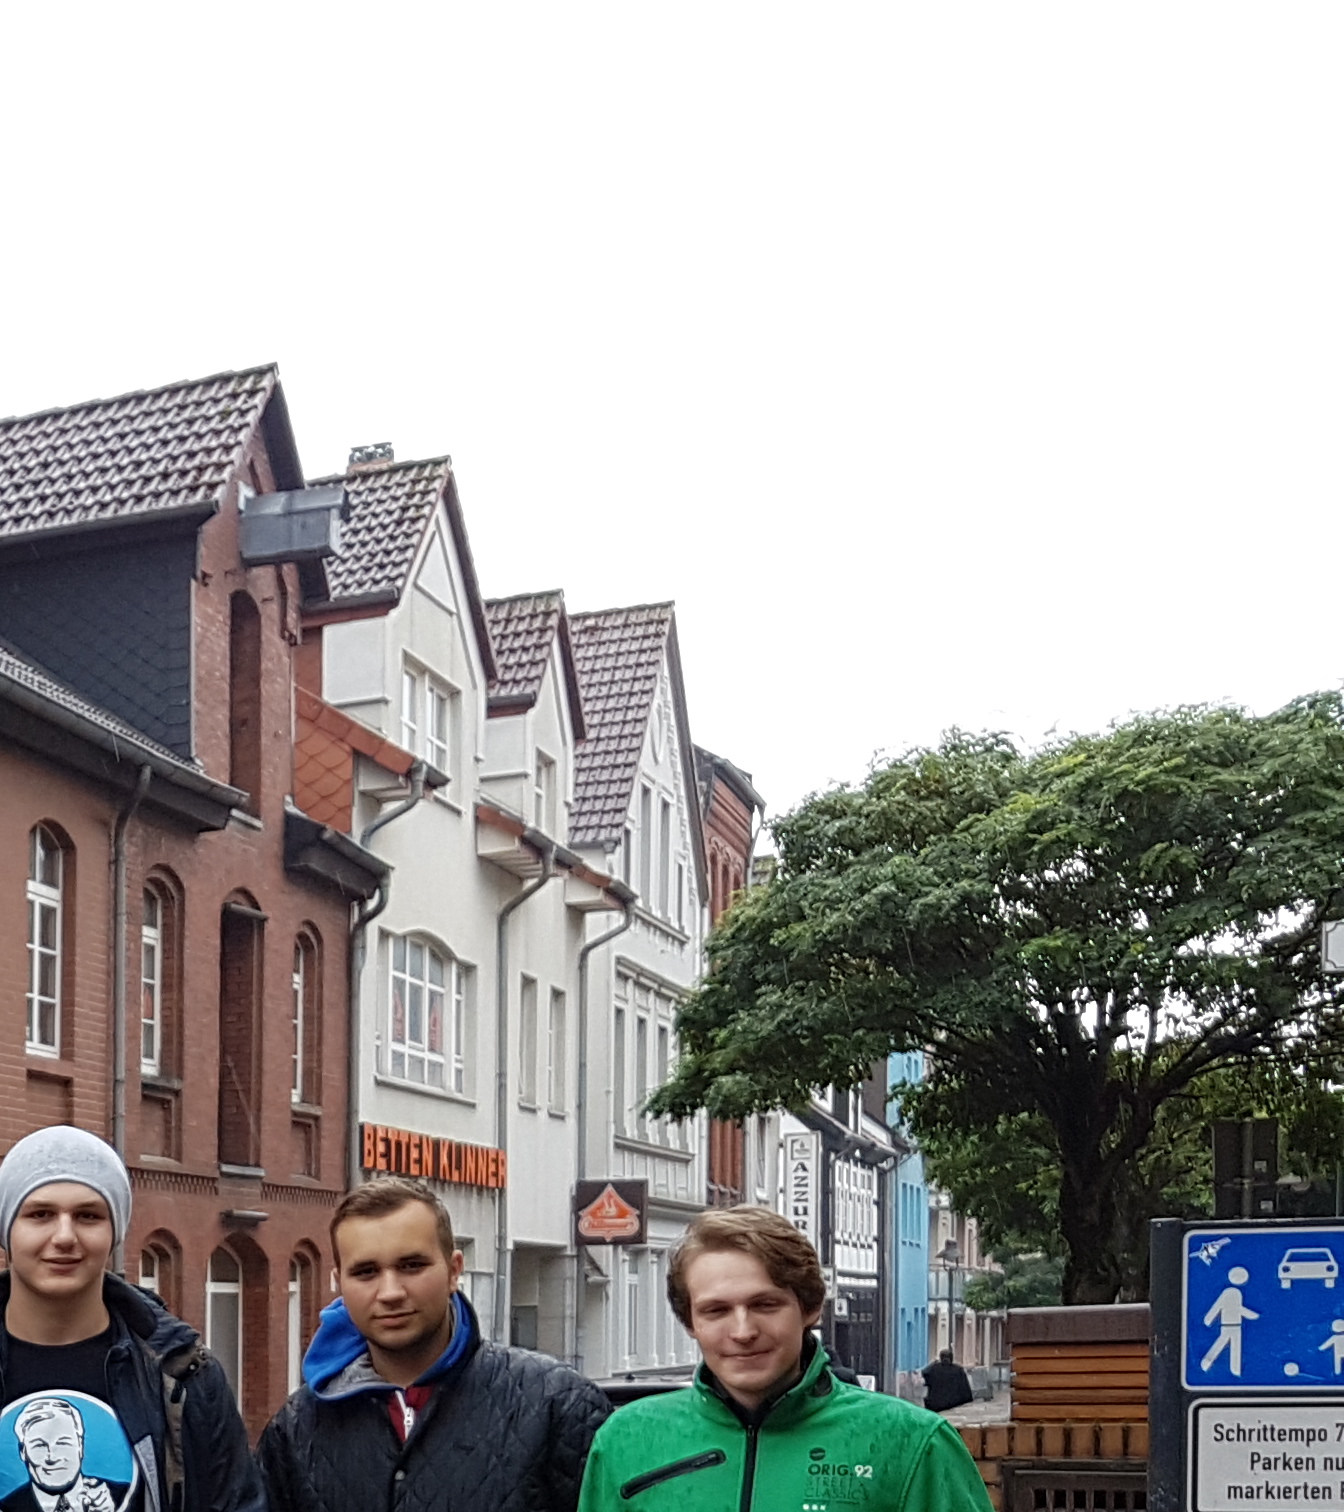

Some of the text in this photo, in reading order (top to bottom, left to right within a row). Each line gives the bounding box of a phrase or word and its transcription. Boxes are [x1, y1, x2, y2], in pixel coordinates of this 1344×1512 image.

[363, 1121, 508, 1189] BETTEN KLINNER
[1213, 1421, 1328, 1448] Schrittempo
[1250, 1451, 1316, 1471] Parken
[1227, 1480, 1332, 1500] markierten
